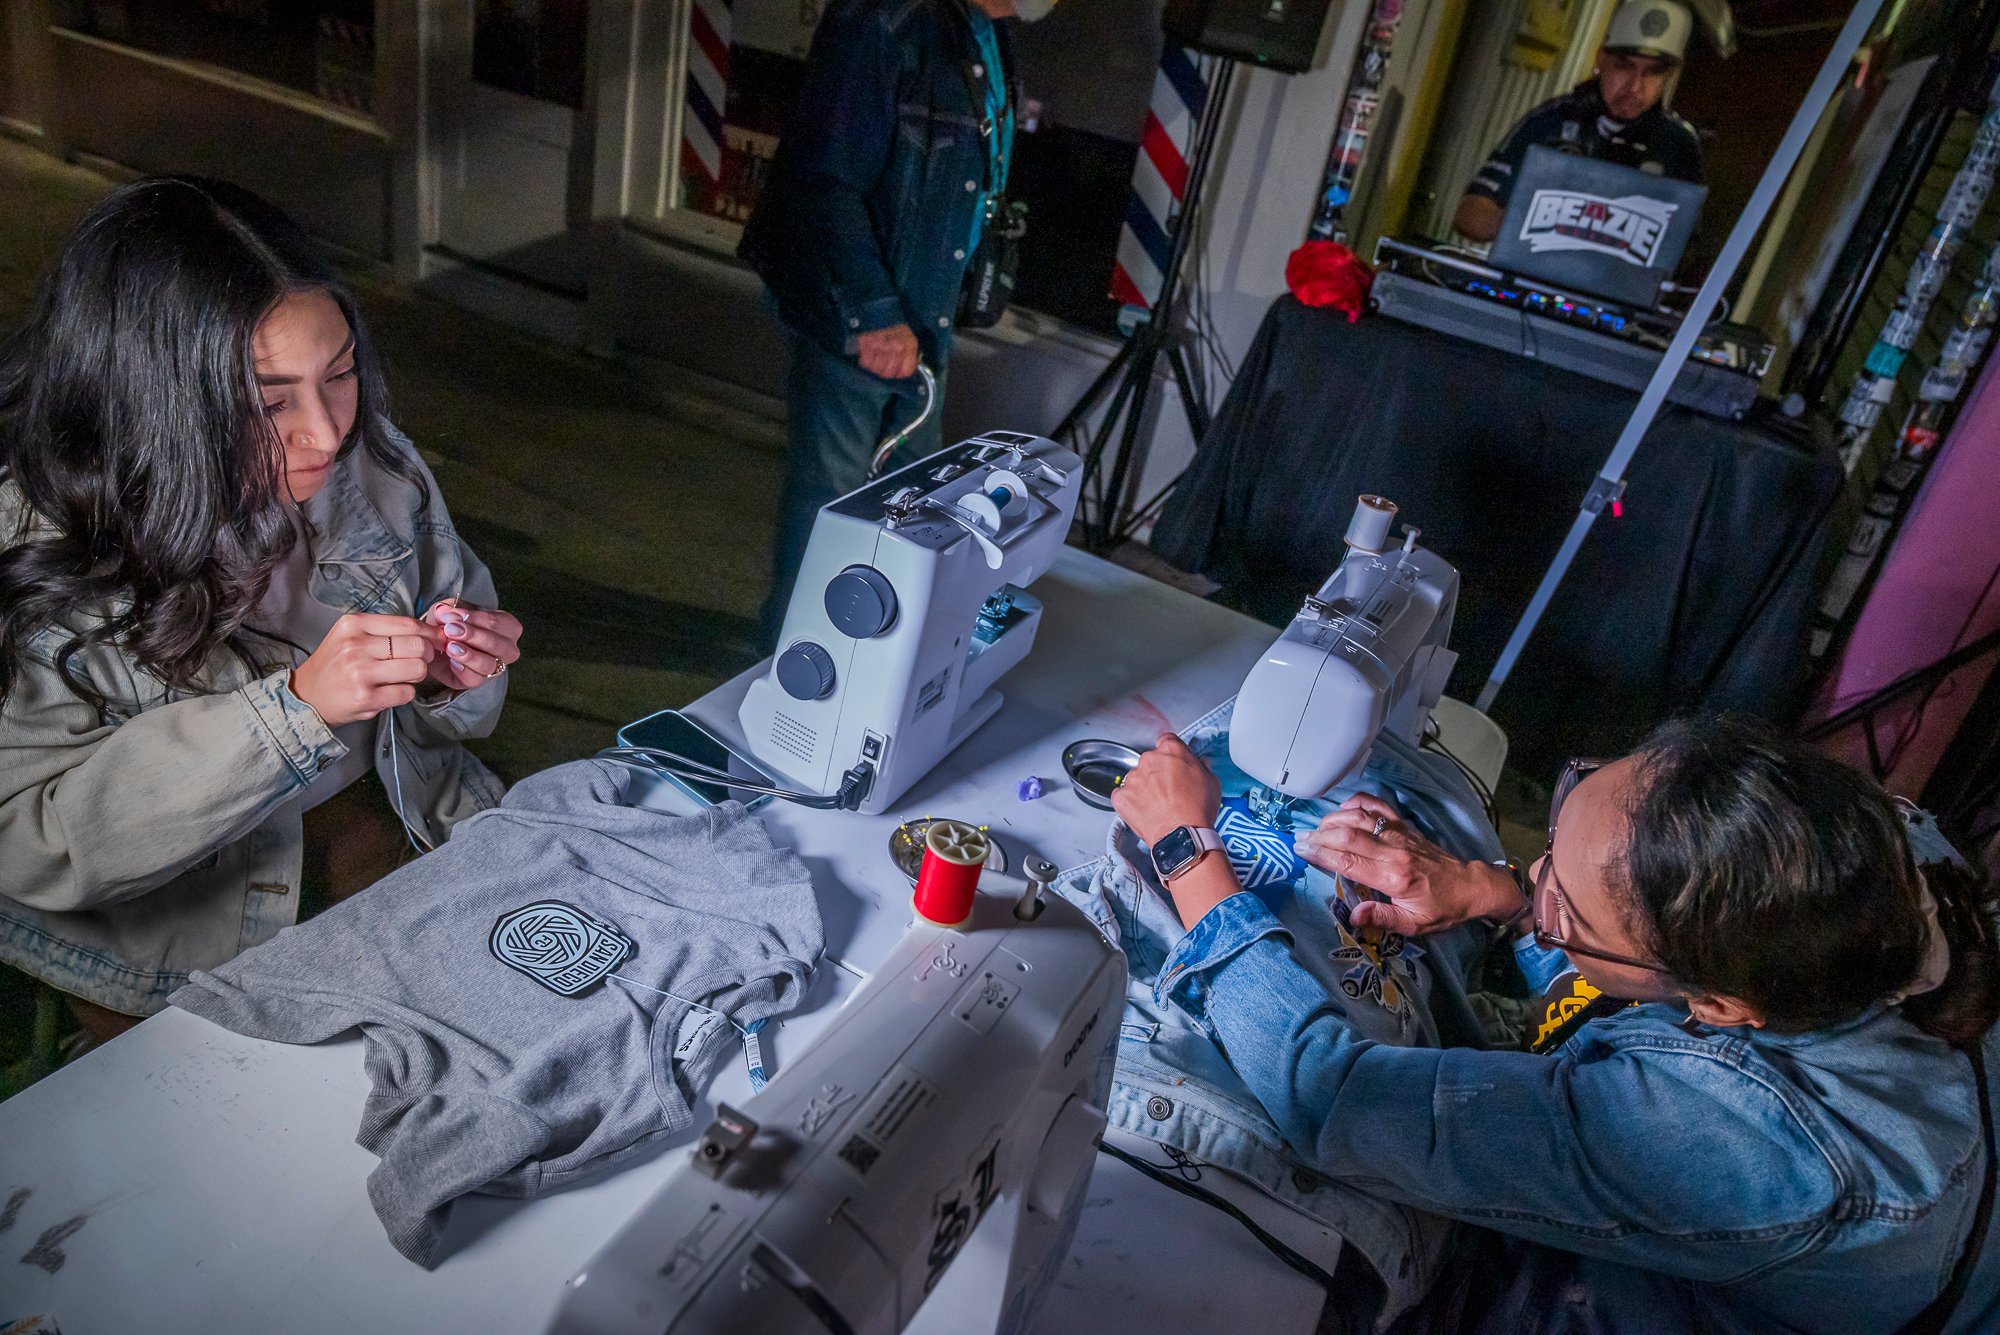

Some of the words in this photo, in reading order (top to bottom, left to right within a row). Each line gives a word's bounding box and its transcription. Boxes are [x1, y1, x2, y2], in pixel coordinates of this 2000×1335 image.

[1528, 196, 1661, 259] BEAZIE
[534, 934, 553, 948] FC
[588, 938, 619, 966] SAN
[552, 959, 600, 987] DIEGO
